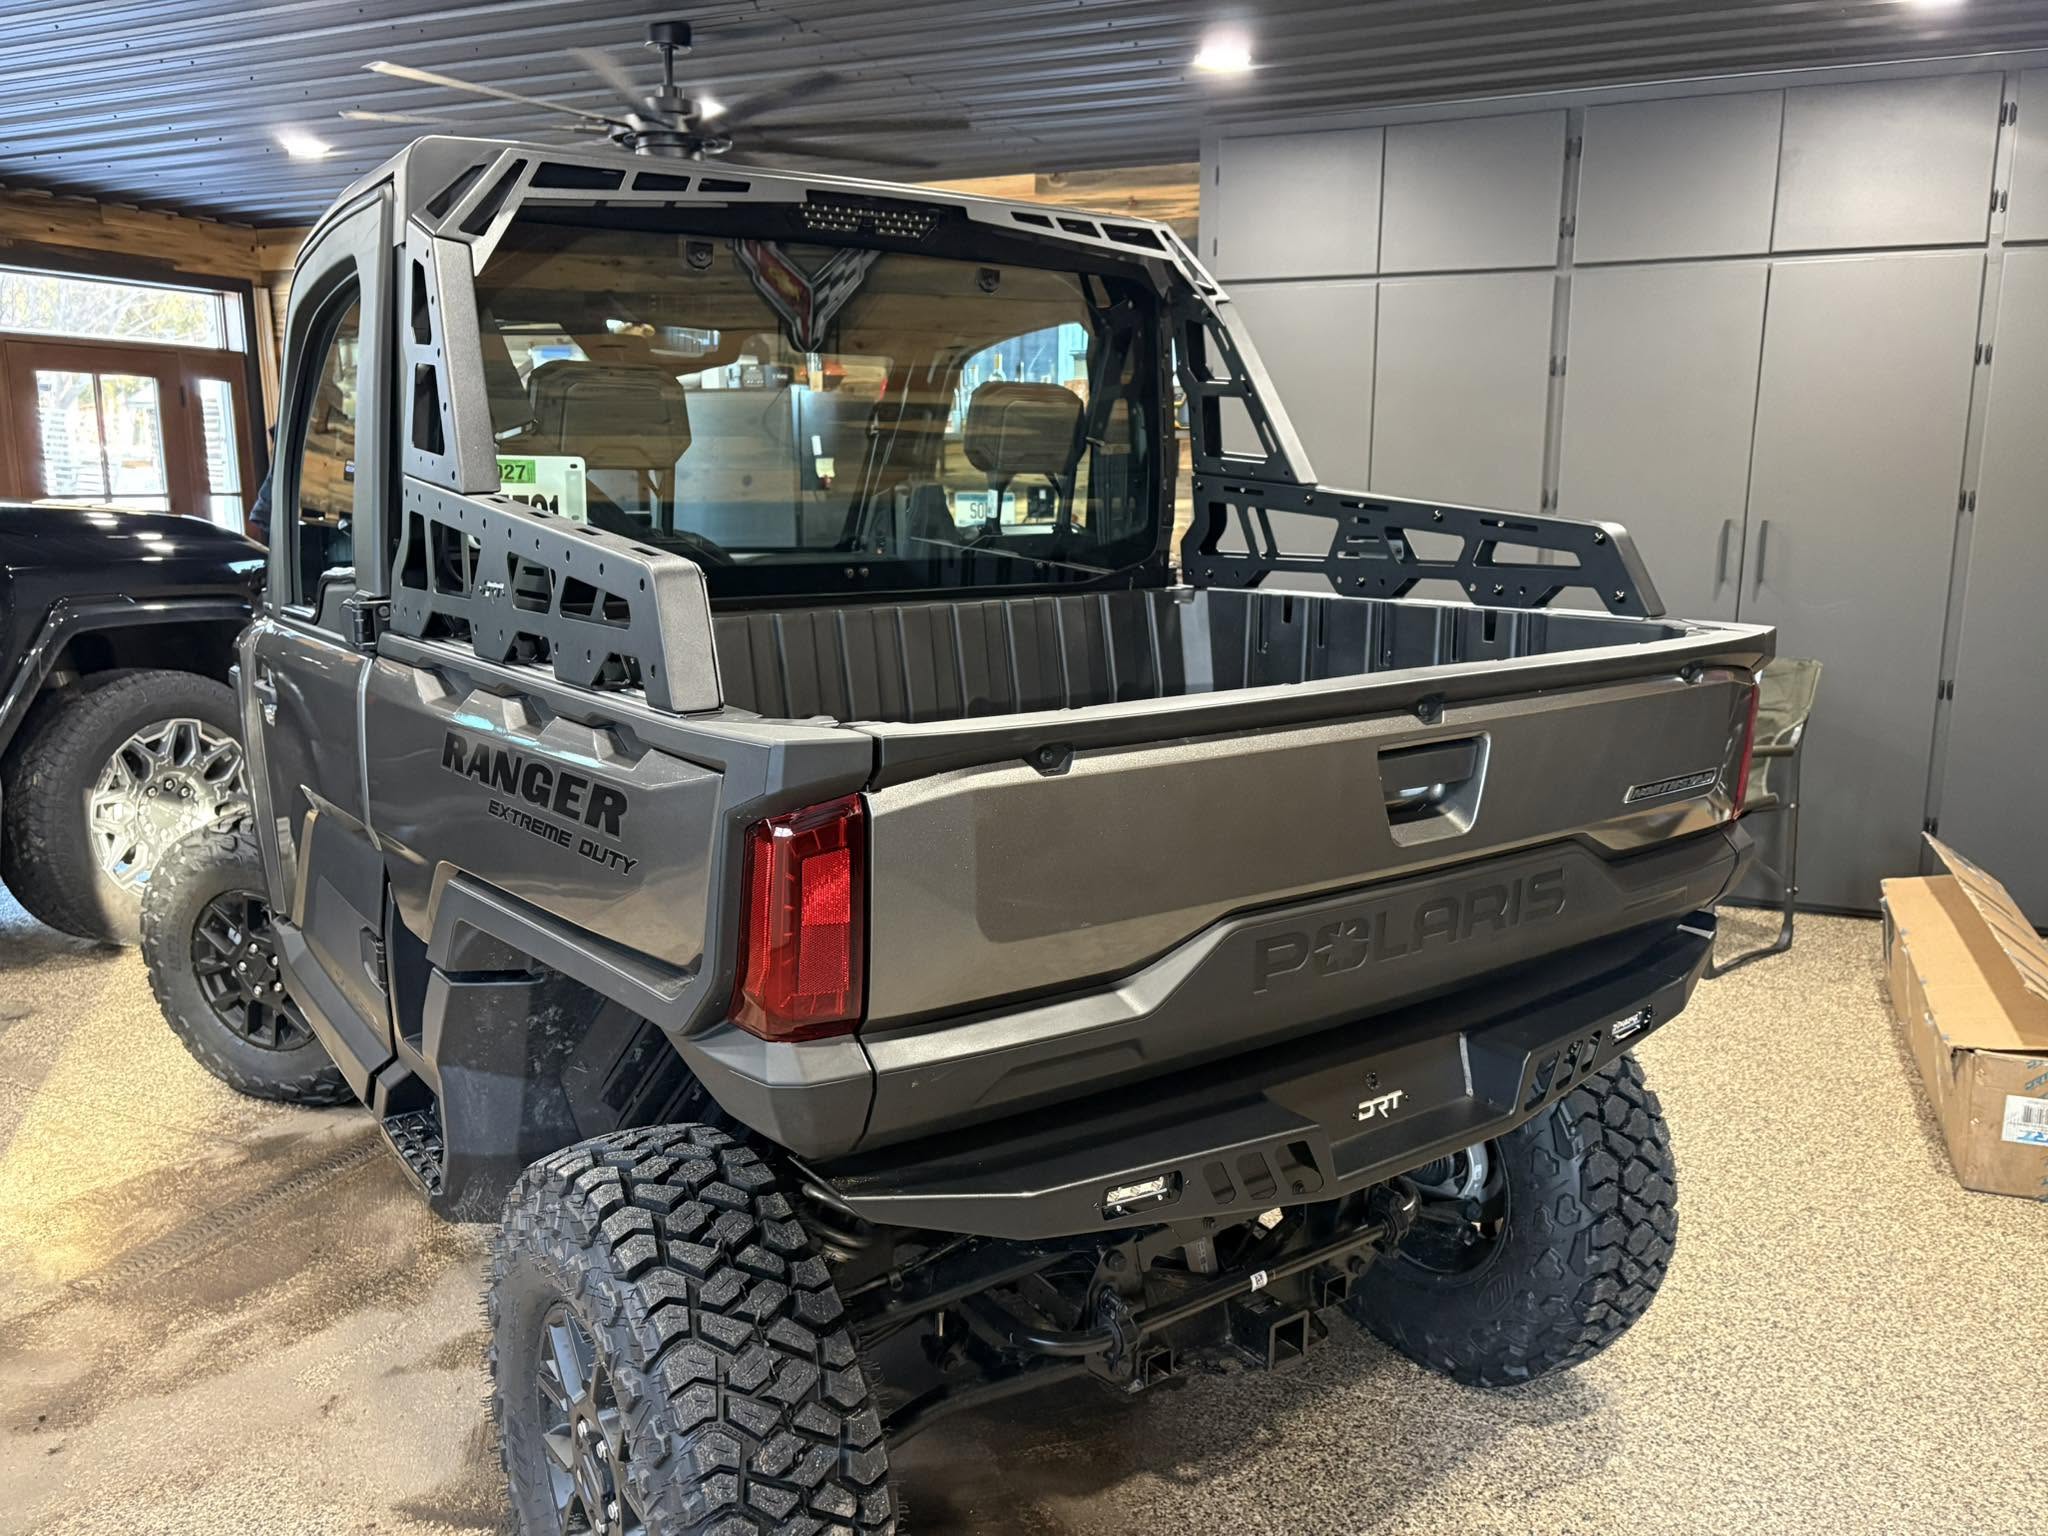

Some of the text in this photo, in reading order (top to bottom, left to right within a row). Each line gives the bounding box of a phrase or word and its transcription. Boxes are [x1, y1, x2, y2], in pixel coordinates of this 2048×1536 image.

[442, 729, 628, 839] RANGER
[488, 799, 638, 875] EXTREME DUTY
[1254, 866, 1566, 995] POLARIS
